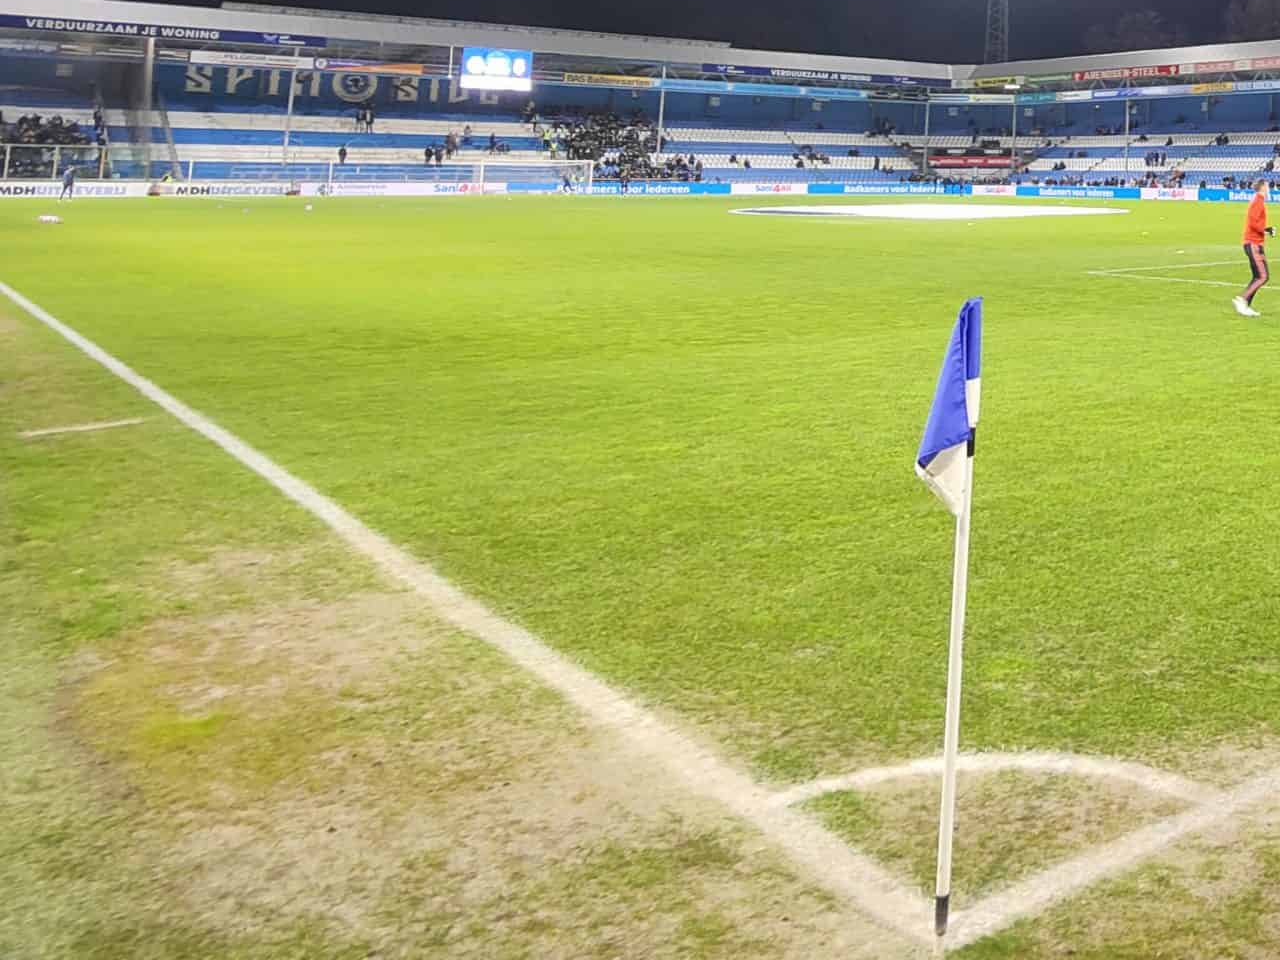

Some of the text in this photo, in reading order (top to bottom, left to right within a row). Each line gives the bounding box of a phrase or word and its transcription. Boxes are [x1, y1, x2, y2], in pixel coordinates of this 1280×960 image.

[25, 18, 220, 39] VERDUURZAAM JE WONING
